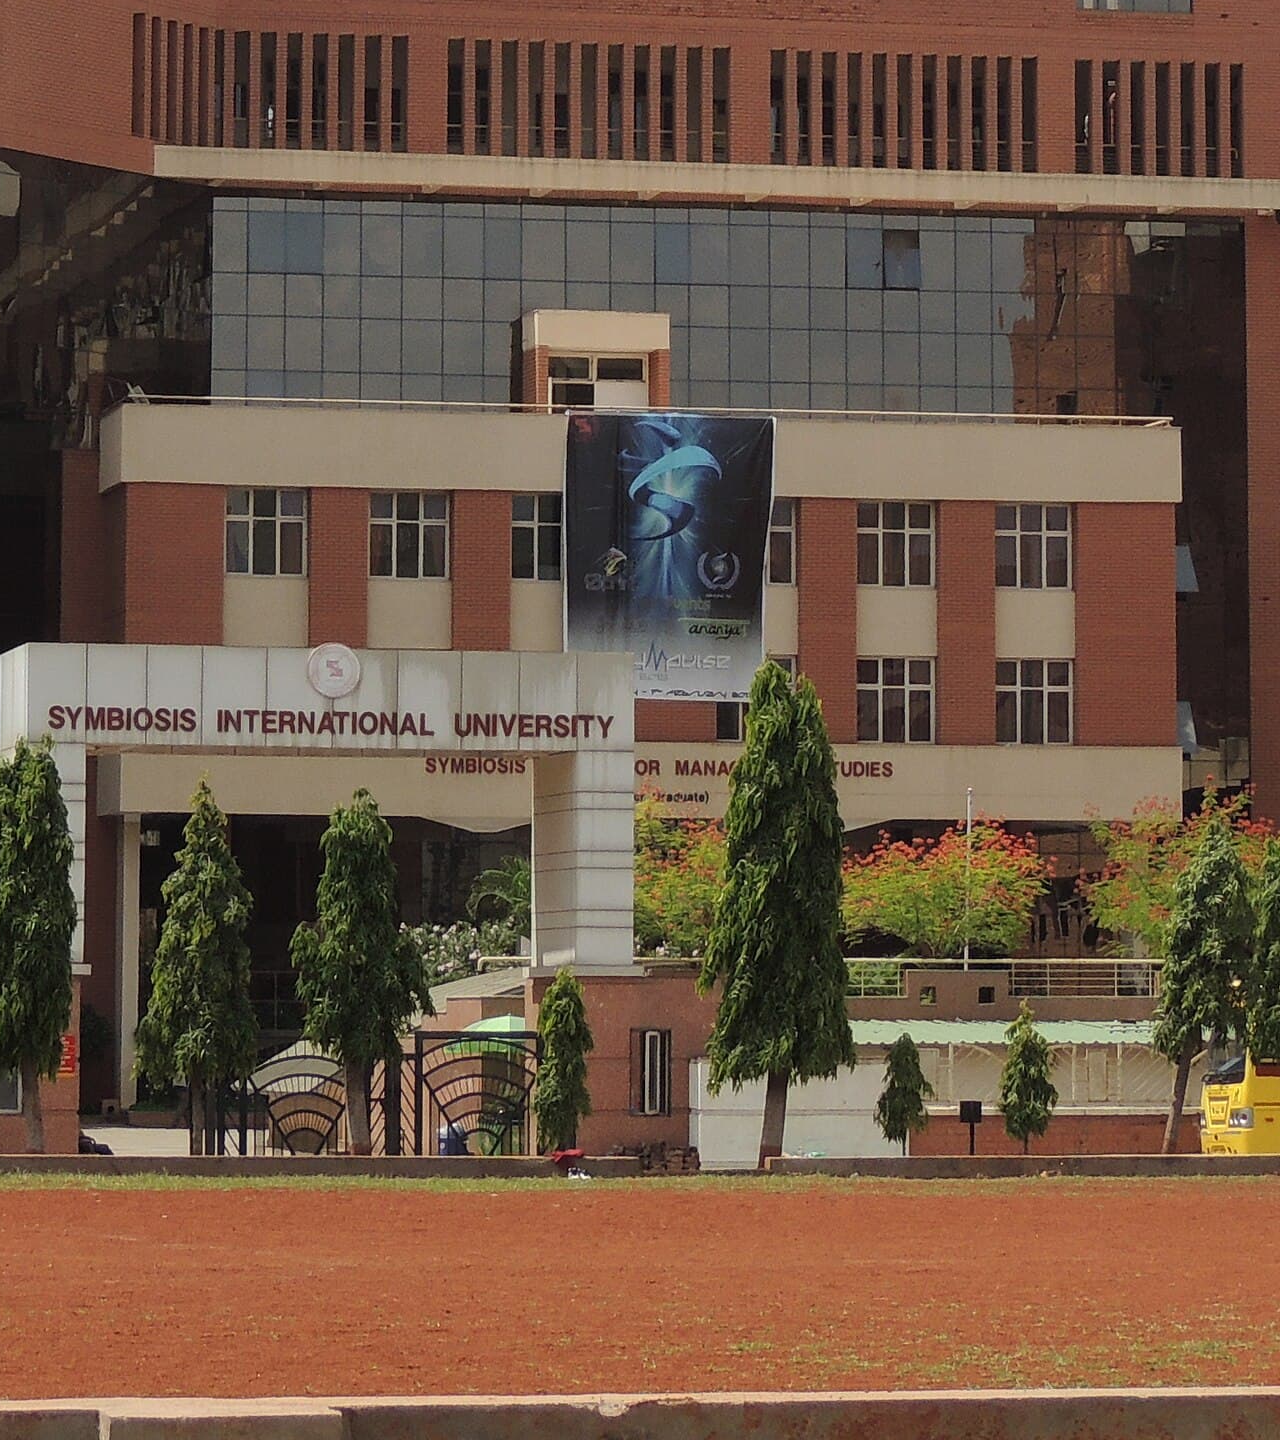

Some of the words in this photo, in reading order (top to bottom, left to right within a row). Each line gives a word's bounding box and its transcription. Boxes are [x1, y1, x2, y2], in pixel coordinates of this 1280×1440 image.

[47, 705, 197, 732] SYMBIOSIS
[217, 709, 435, 737] INTERNATIONAL
[454, 713, 614, 739] UNIVERSITY
[425, 758, 526, 774] SYMBIOSIS
